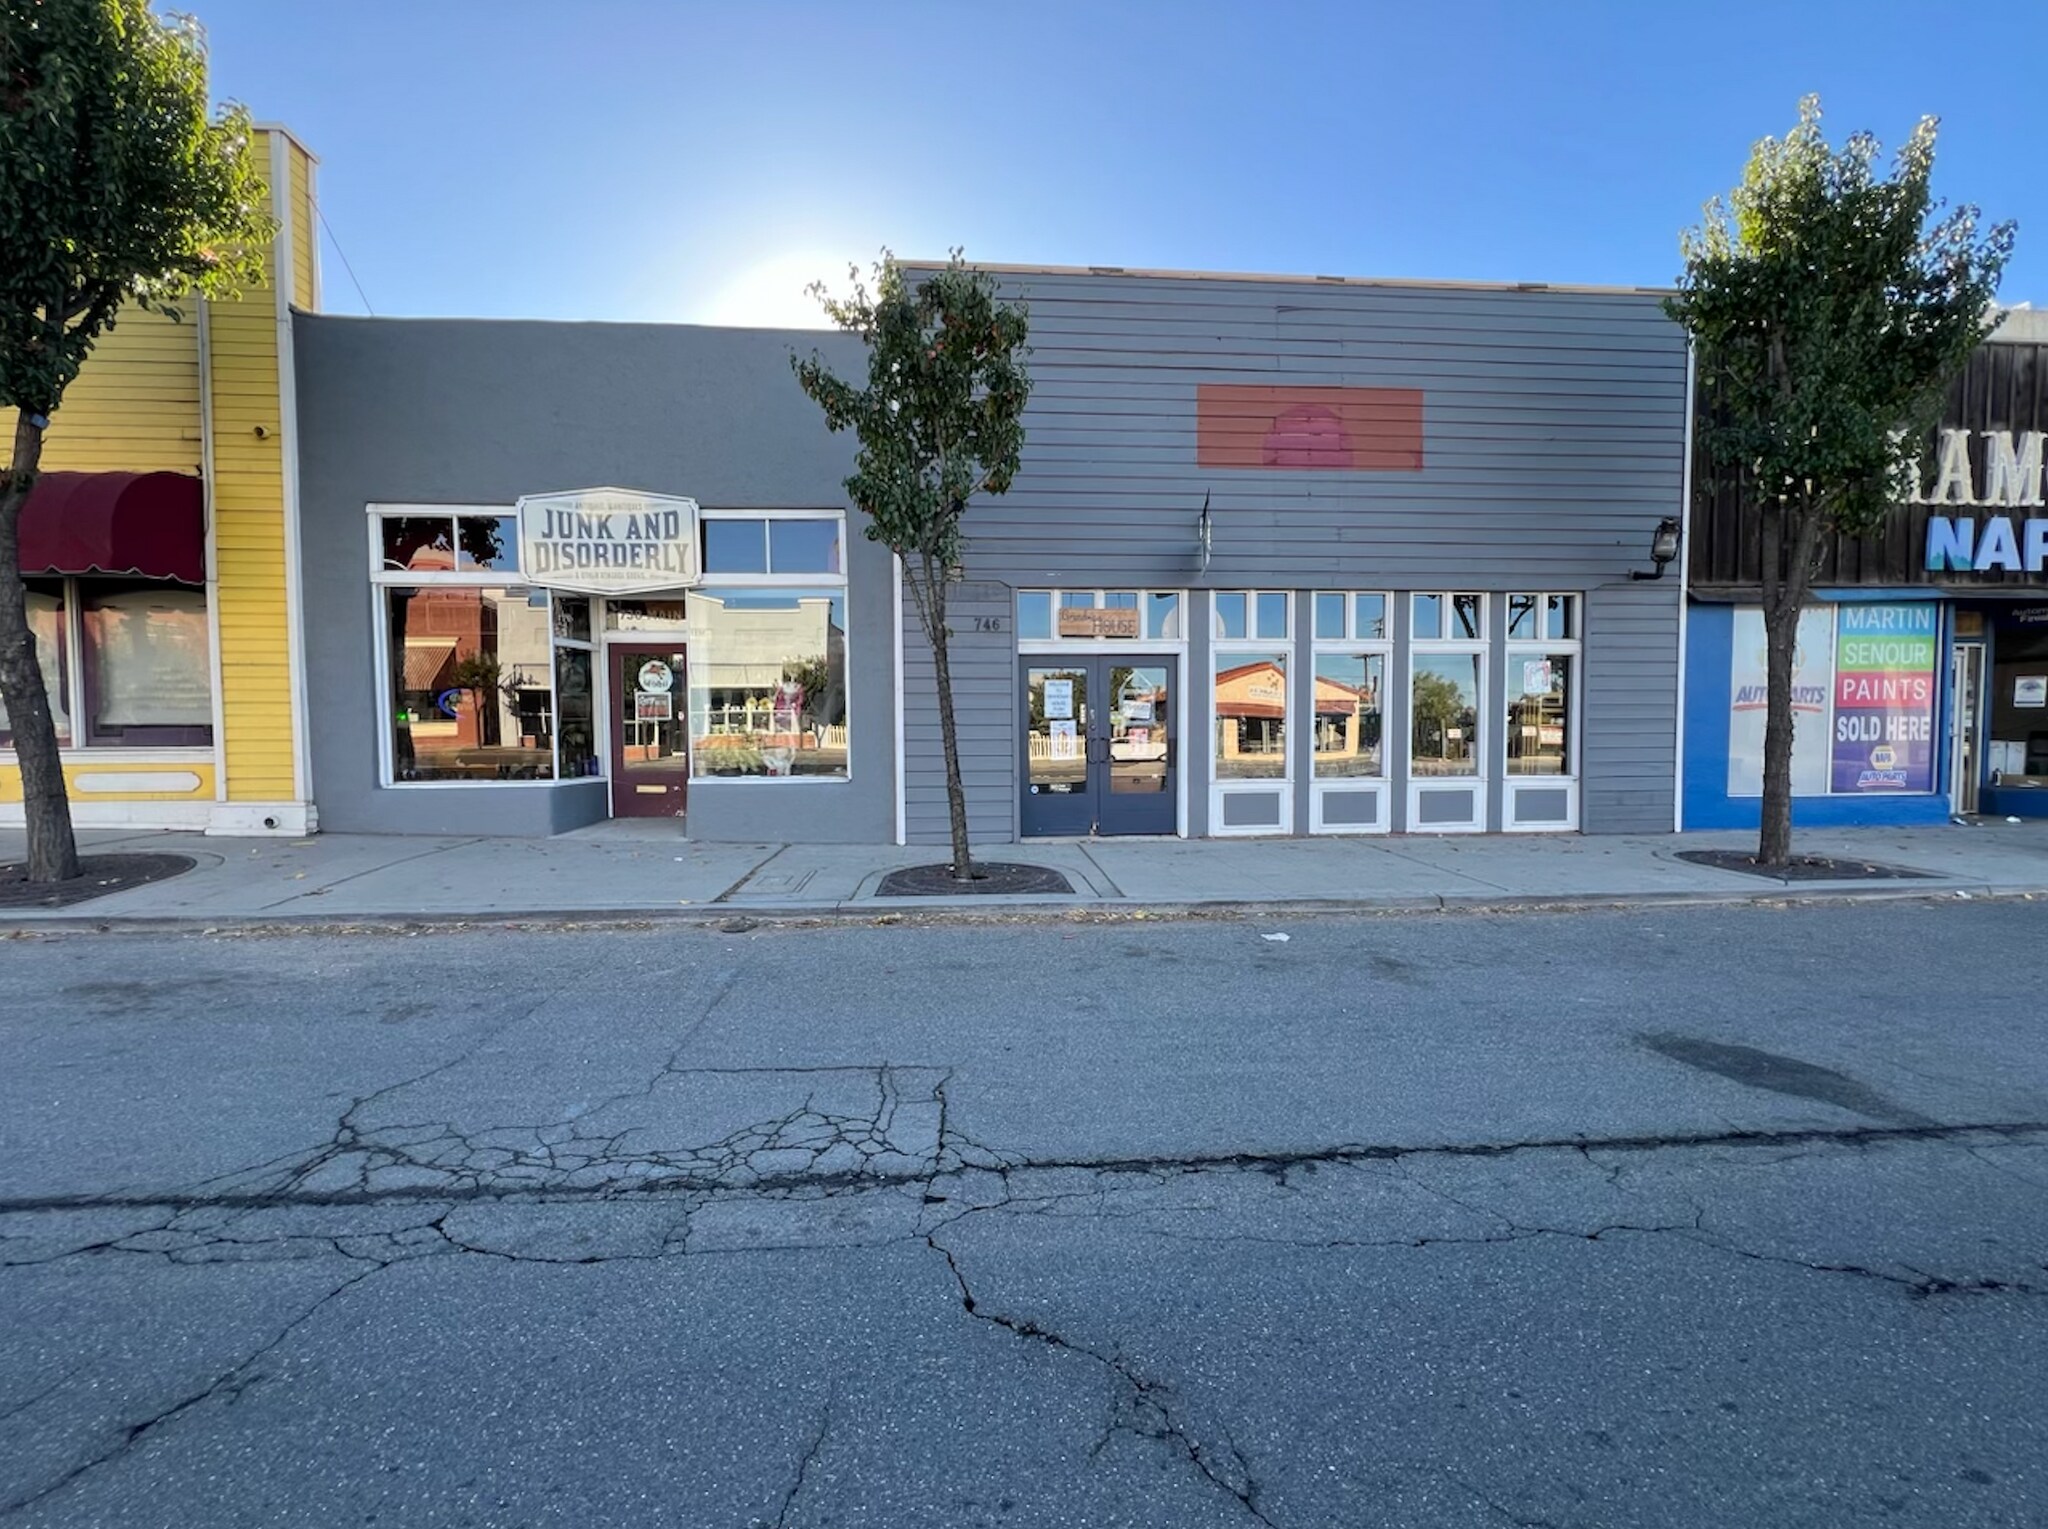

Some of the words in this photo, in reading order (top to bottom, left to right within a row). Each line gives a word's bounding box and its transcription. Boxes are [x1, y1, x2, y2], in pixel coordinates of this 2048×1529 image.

[1885, 428, 2048, 507] AM
[541, 508, 614, 539] JUNK
[626, 510, 680, 540] AND
[533, 540, 689, 574] DISORDERLY
[974, 617, 1001, 632] 746
[1092, 619, 1137, 634] HOUSE
[1846, 608, 1930, 630] MARTIN
[1844, 642, 1928, 665] SENOUR
[1735, 685, 1769, 703] AUT
[1791, 685, 1826, 704] ARTS
[1842, 678, 1928, 701] PAINTS
[1836, 715, 1881, 742] SOLD
[1886, 715, 1930, 741] HERE
